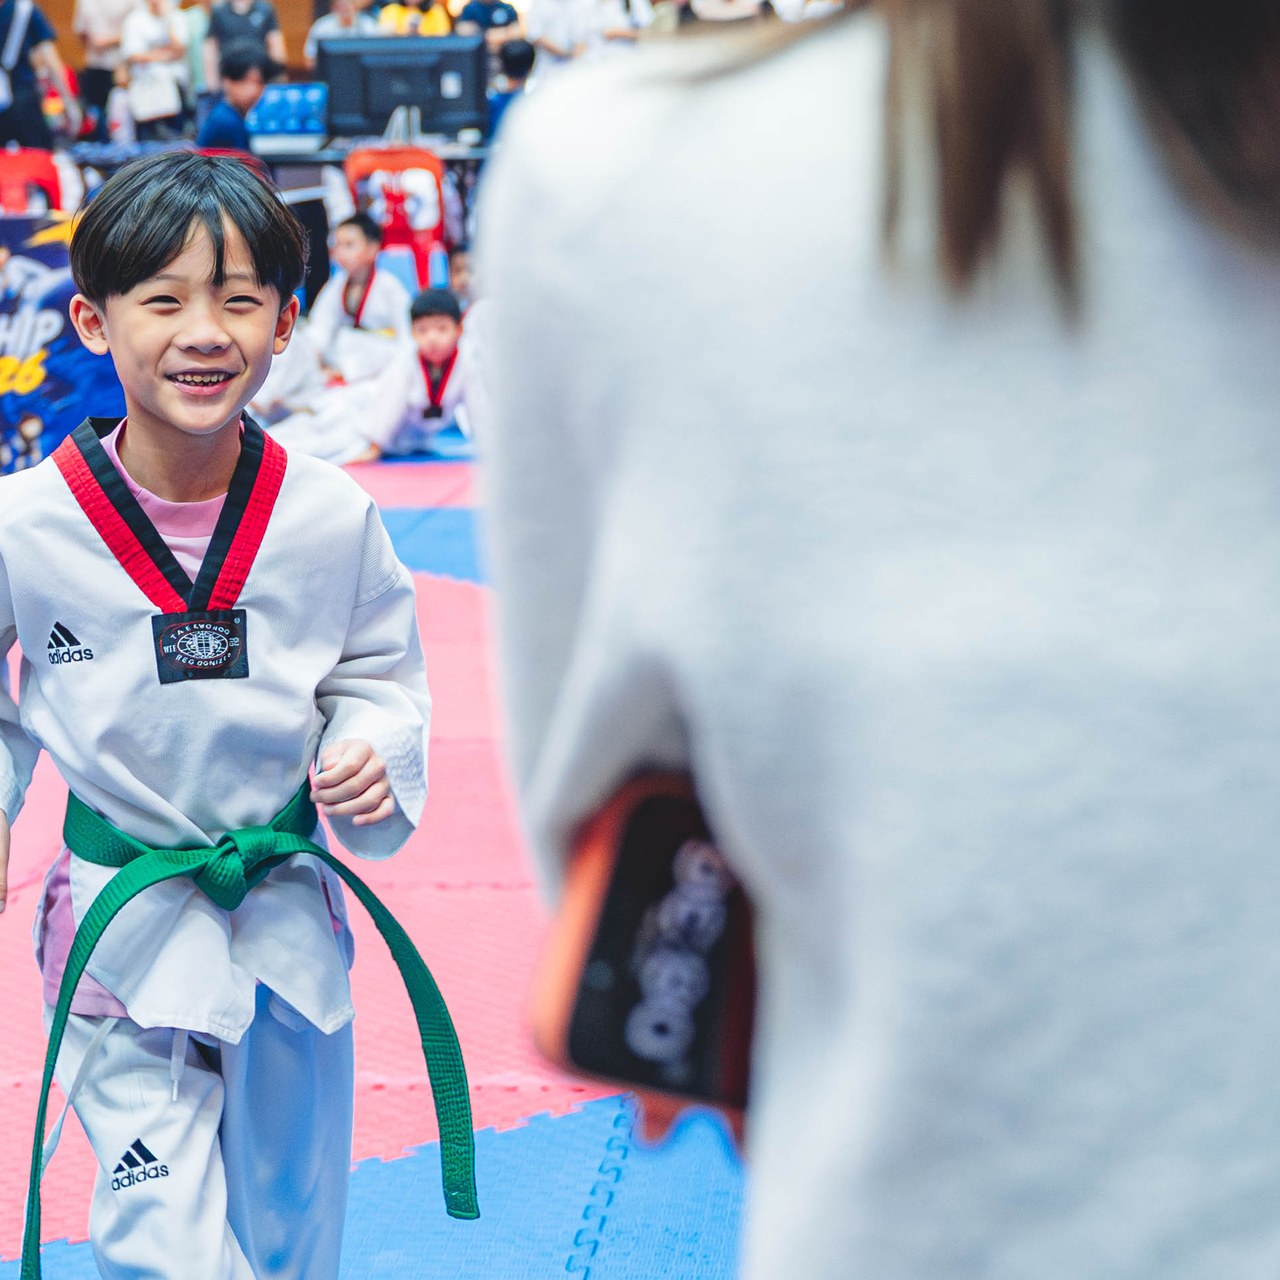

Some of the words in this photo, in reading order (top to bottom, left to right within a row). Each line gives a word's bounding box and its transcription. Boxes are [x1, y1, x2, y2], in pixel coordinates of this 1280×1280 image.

[170, 623, 230, 640] TAEKWONDO
[48, 647, 94, 665] adidas
[111, 1164, 169, 1191] adidas
